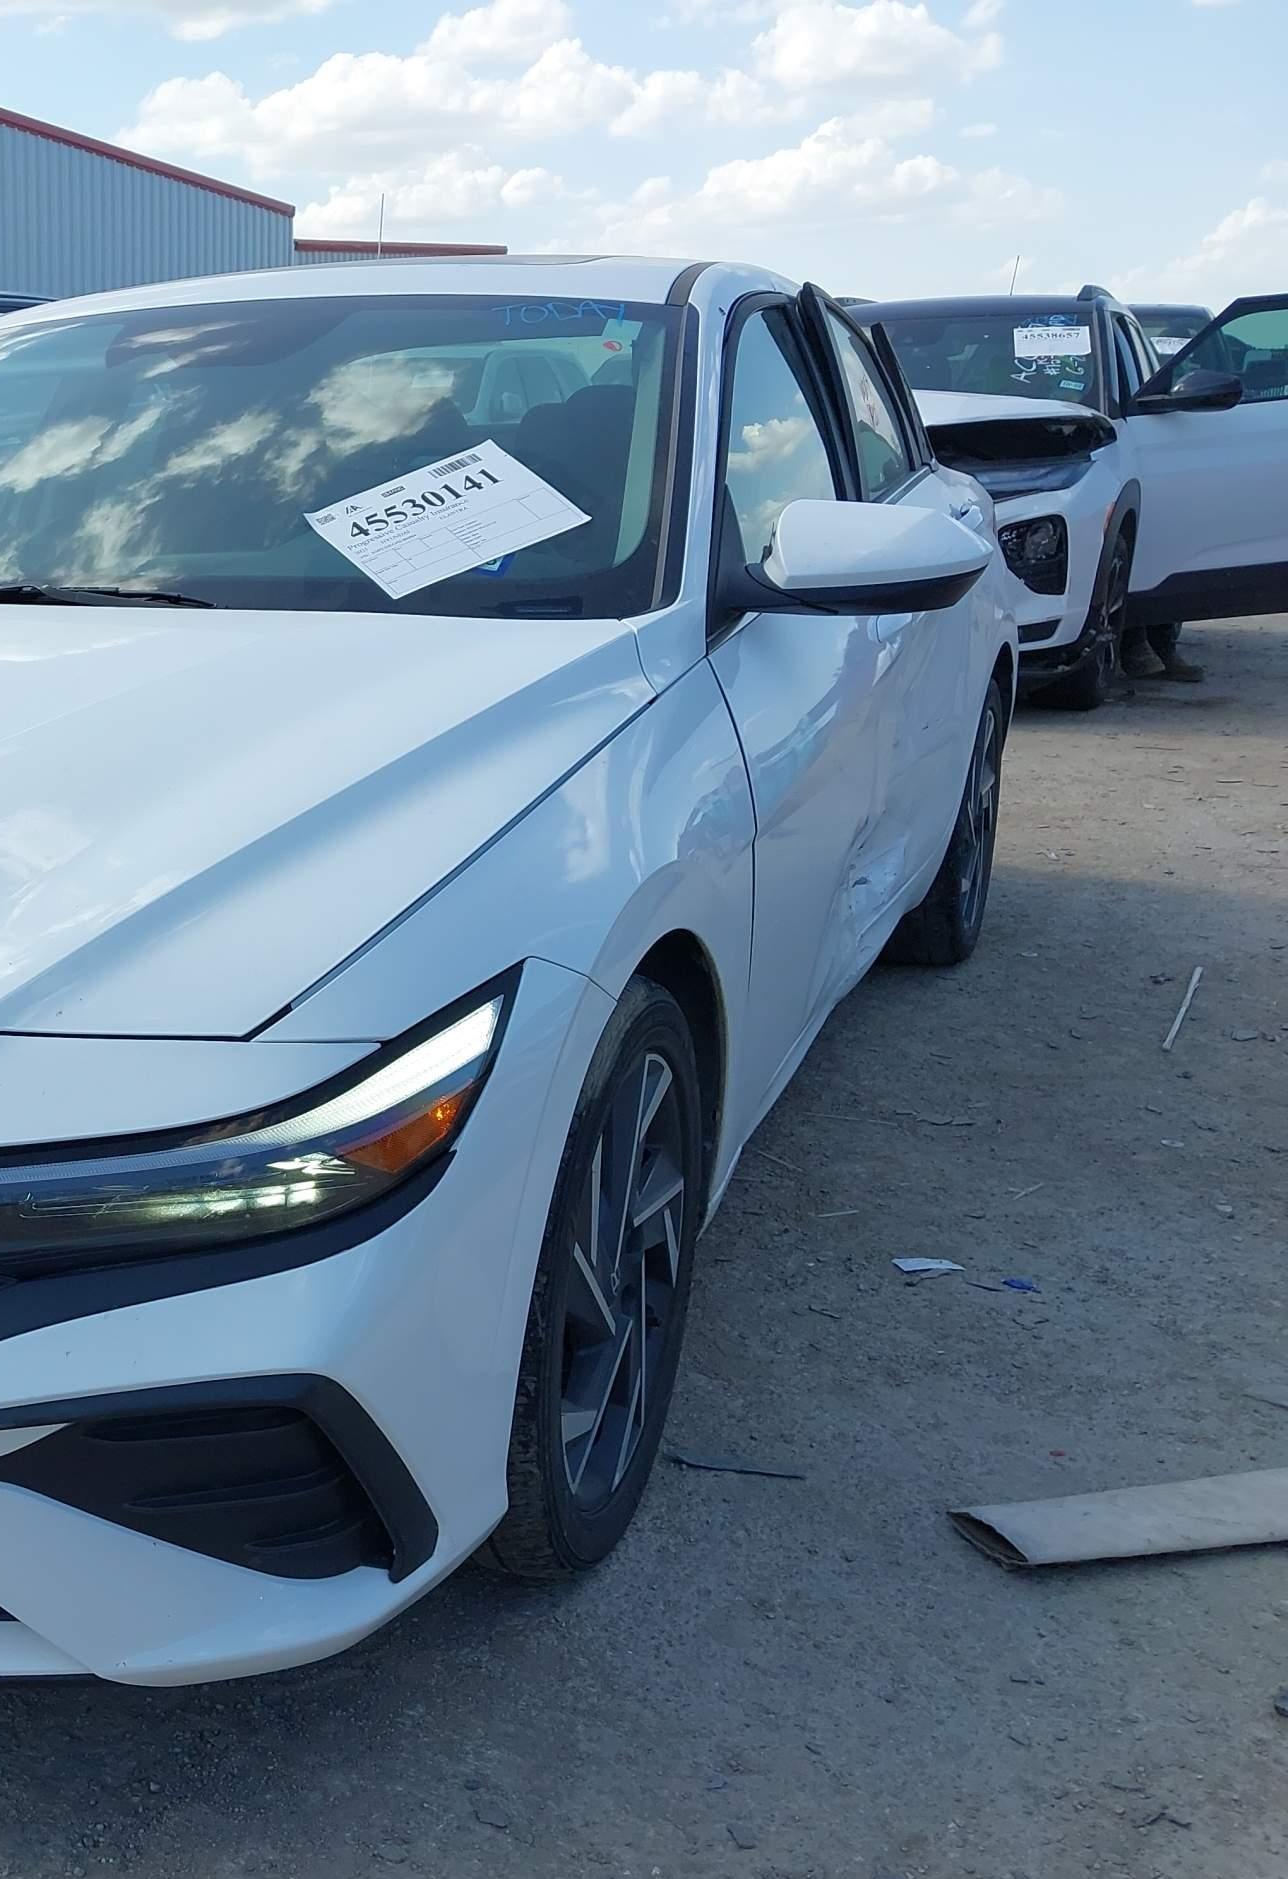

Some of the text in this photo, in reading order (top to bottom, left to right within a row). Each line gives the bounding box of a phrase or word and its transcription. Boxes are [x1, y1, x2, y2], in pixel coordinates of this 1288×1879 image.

[491, 300, 625, 328] TODAY
[350, 468, 504, 537] 45530141
[347, 530, 394, 551] Progressive
[394, 514, 430, 531] Casualty
